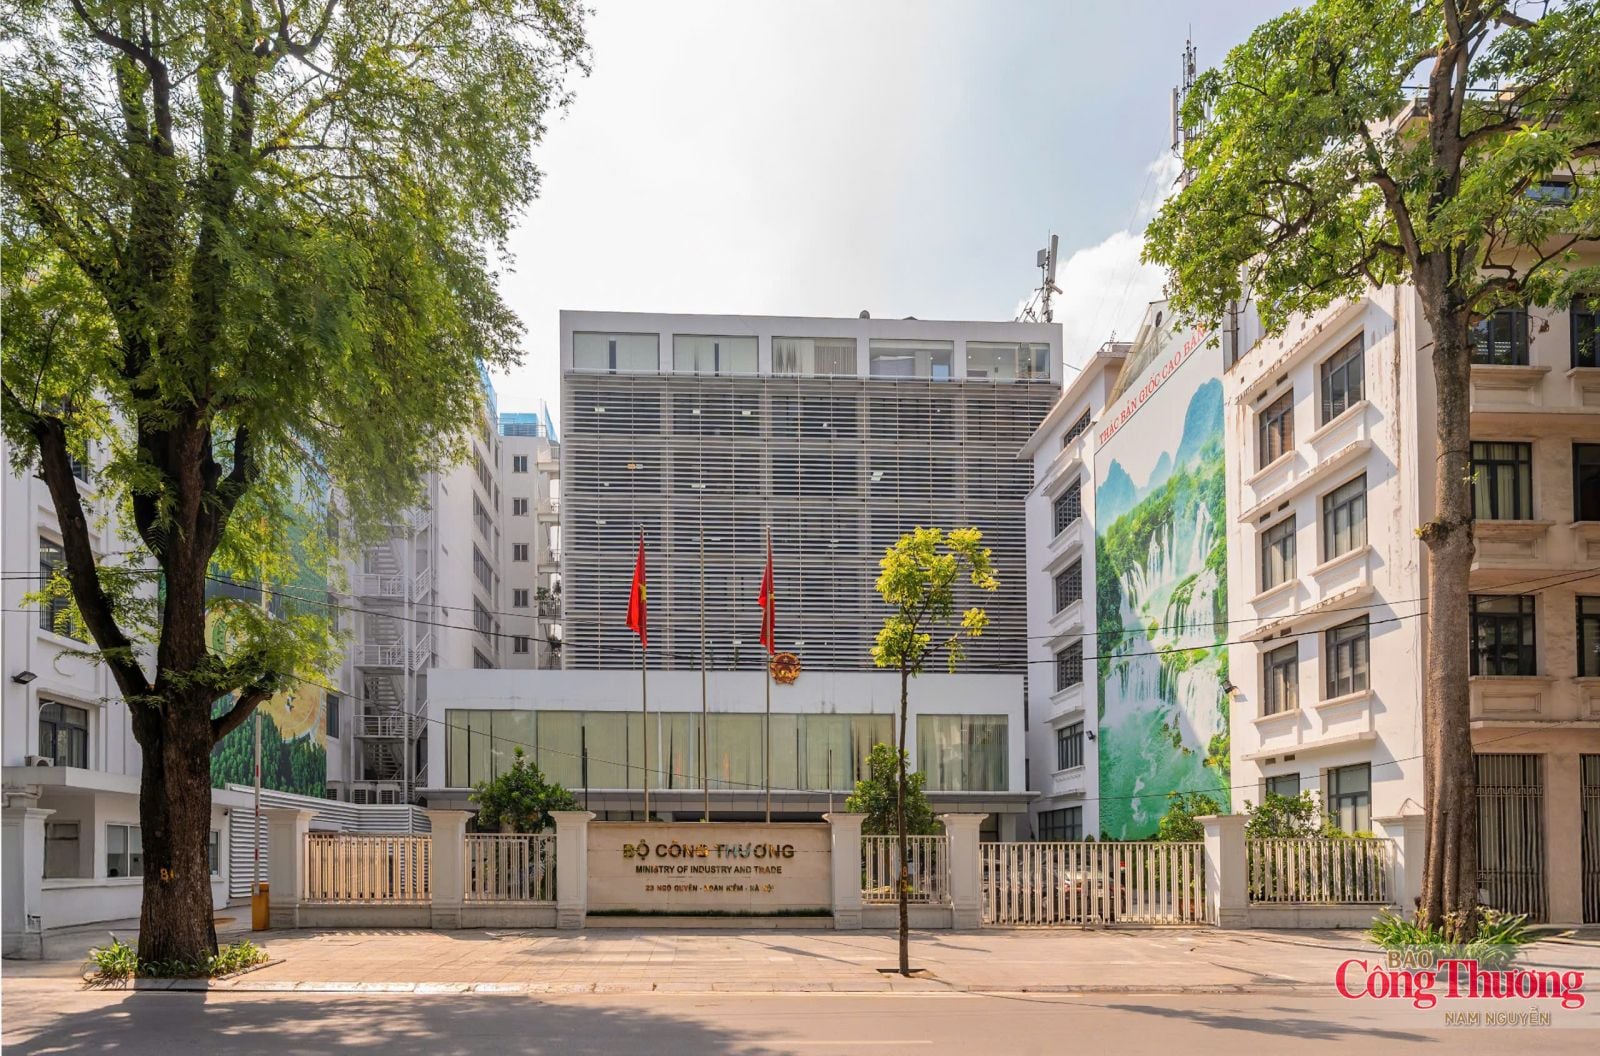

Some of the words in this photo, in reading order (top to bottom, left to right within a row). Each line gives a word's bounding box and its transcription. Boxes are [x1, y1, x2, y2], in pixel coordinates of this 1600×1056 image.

[1162, 351, 1181, 379] CAO
[623, 839, 650, 861] BỘ
[655, 840, 710, 858] CÔNG
[715, 842, 795, 859] THƯƠNG
[635, 865, 675, 874] MINISTRY
[677, 865, 688, 874] OF
[690, 865, 733, 874] INDUSTRY
[733, 865, 752, 874] AND
[754, 866, 783, 874] TRADE
